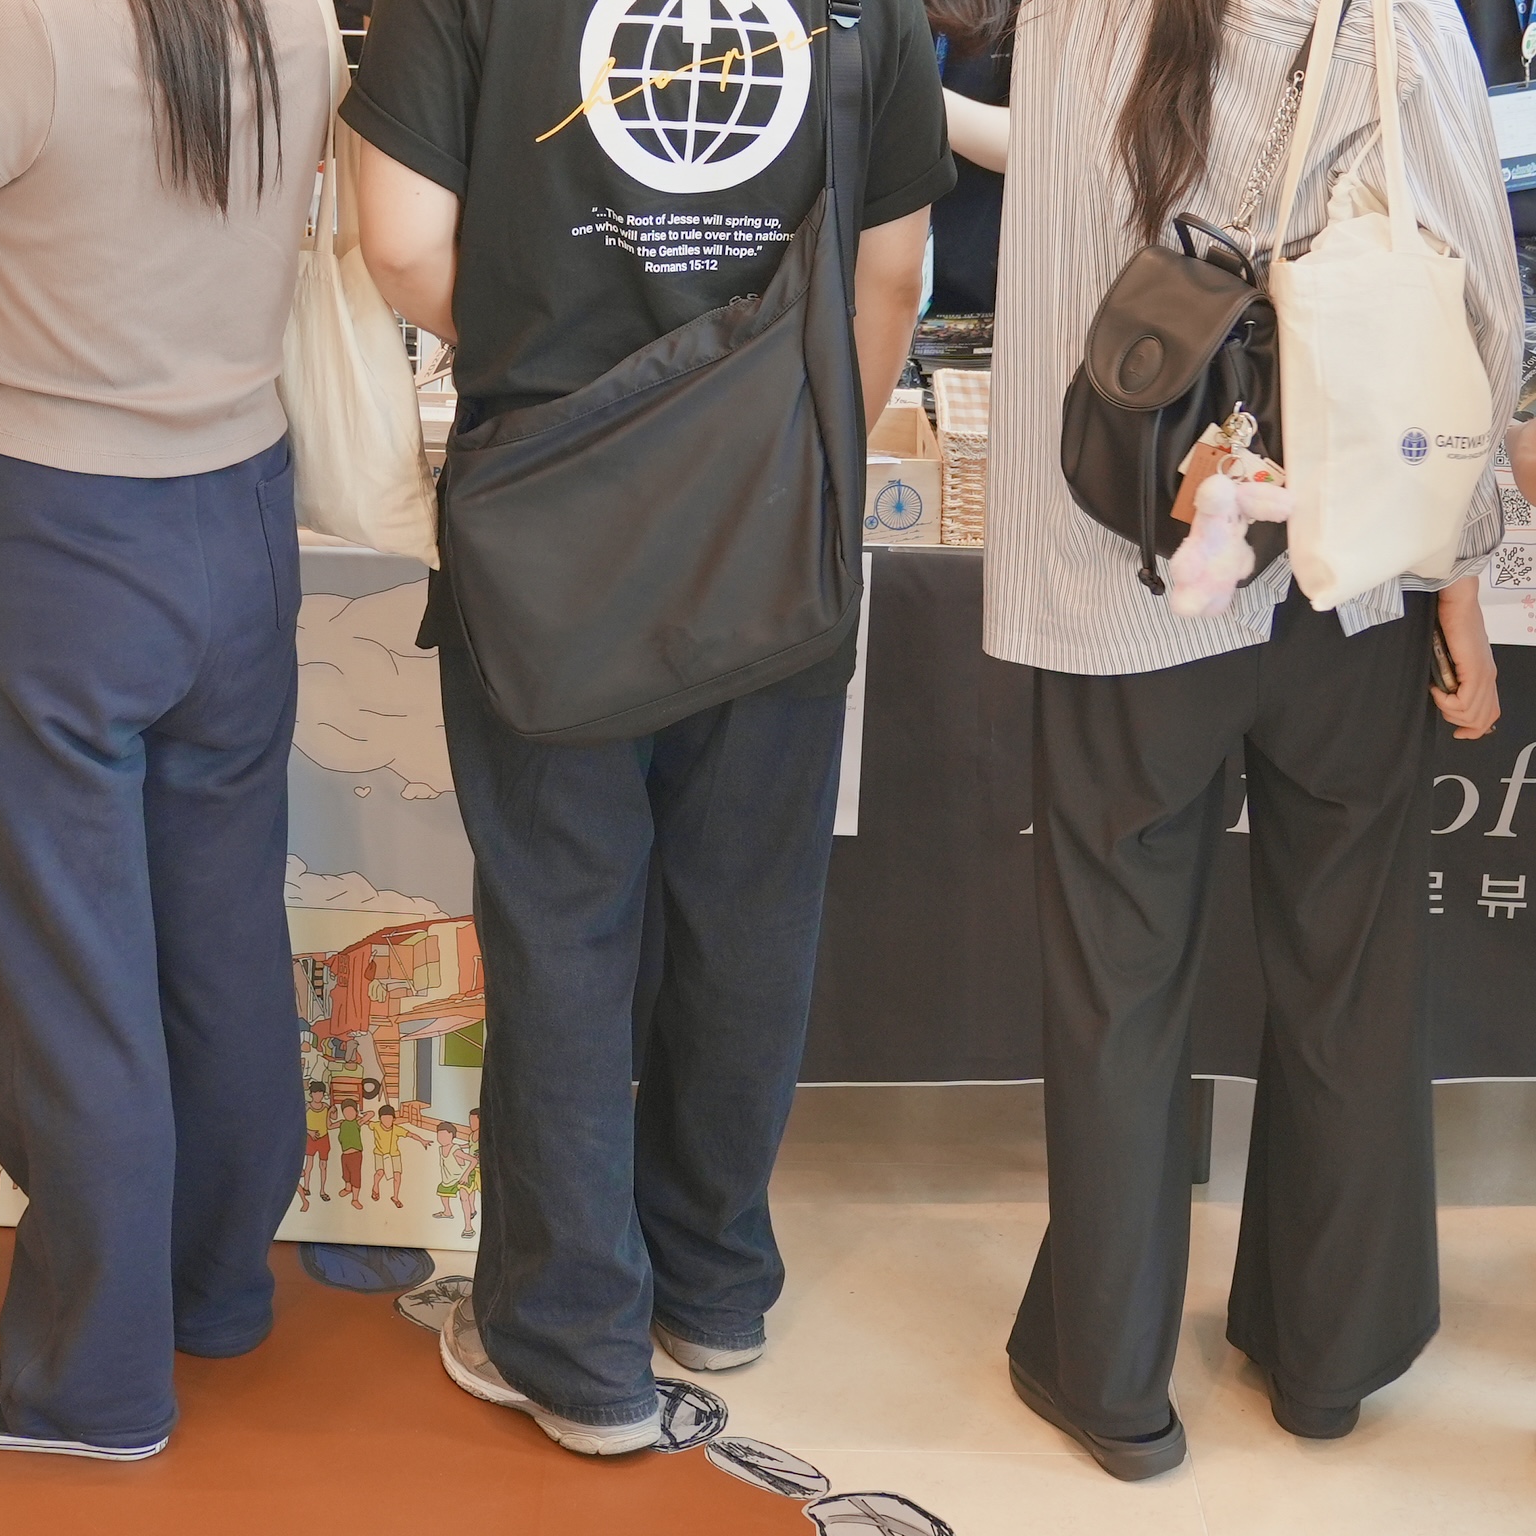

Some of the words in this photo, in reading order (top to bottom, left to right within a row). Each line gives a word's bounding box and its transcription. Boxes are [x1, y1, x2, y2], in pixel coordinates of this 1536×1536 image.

[626, 214, 654, 226] Root
[655, 213, 666, 226] of
[667, 213, 700, 225] Jesse
[702, 213, 723, 226] will
[725, 215, 762, 229] spring
[764, 218, 782, 229] up,
[571, 224, 593, 237] one
[595, 221, 619, 234] who
[620, 226, 638, 242] will
[640, 229, 667, 242] arise
[668, 230, 679, 241] to
[680, 229, 703, 241] rule
[704, 231, 731, 241] over
[733, 230, 753, 242] the
[754, 231, 795, 242] nations
[604, 235, 616, 246] in
[617, 236, 635, 255] him
[636, 245, 657, 257] the
[658, 245, 701, 257] Gentiles
[702, 244, 723, 256] will
[644, 261, 688, 273] Romans
[689, 259, 718, 272] 15:12
